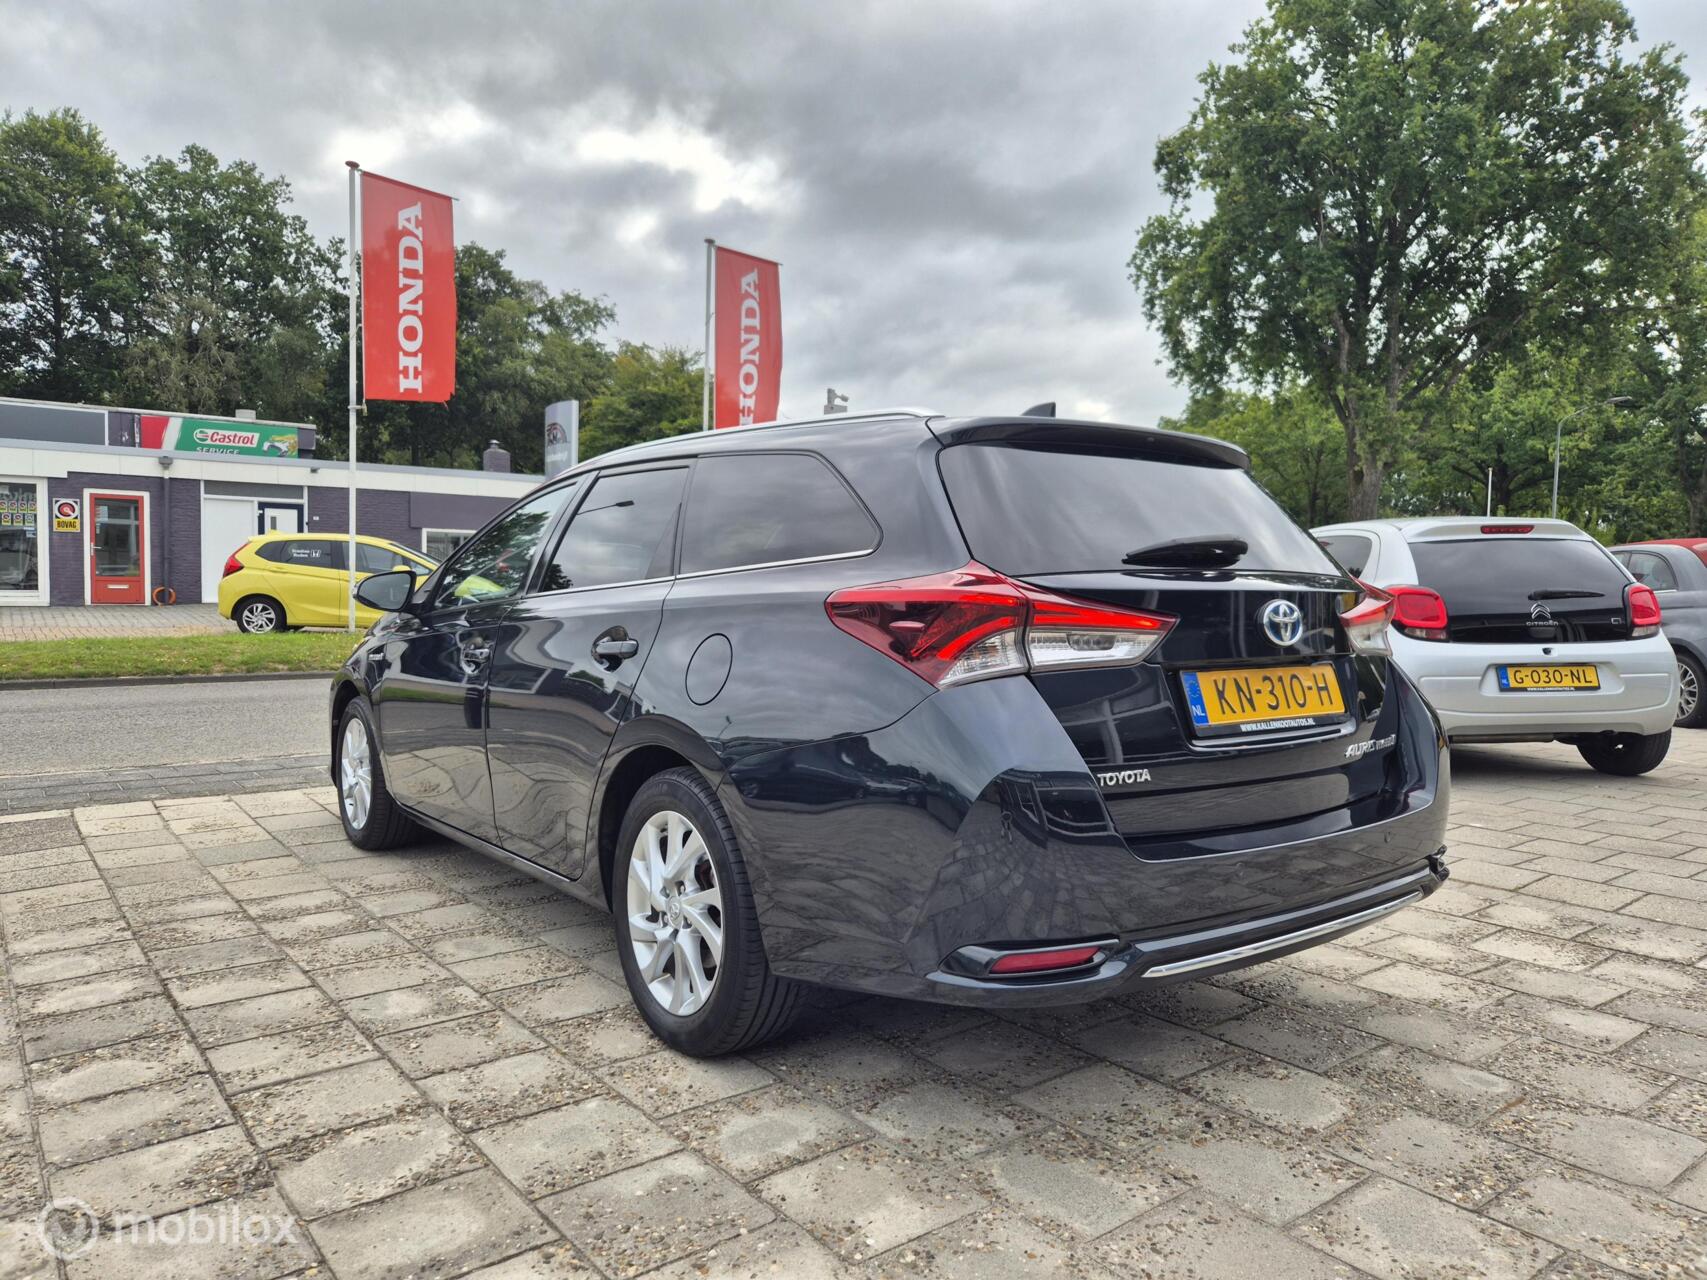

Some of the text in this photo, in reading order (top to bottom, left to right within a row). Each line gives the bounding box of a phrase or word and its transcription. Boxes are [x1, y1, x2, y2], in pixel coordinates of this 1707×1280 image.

[398, 201, 423, 394] HONDA
[739, 267, 761, 427] HONDA
[210, 431, 255, 446] Castrol
[196, 446, 240, 455] SERVICE
[1513, 669, 1592, 684] G-030-NL
[1213, 673, 1333, 715] KN-310-H
[1192, 704, 1205, 716] NL
[1097, 769, 1151, 786] TOYOTA
